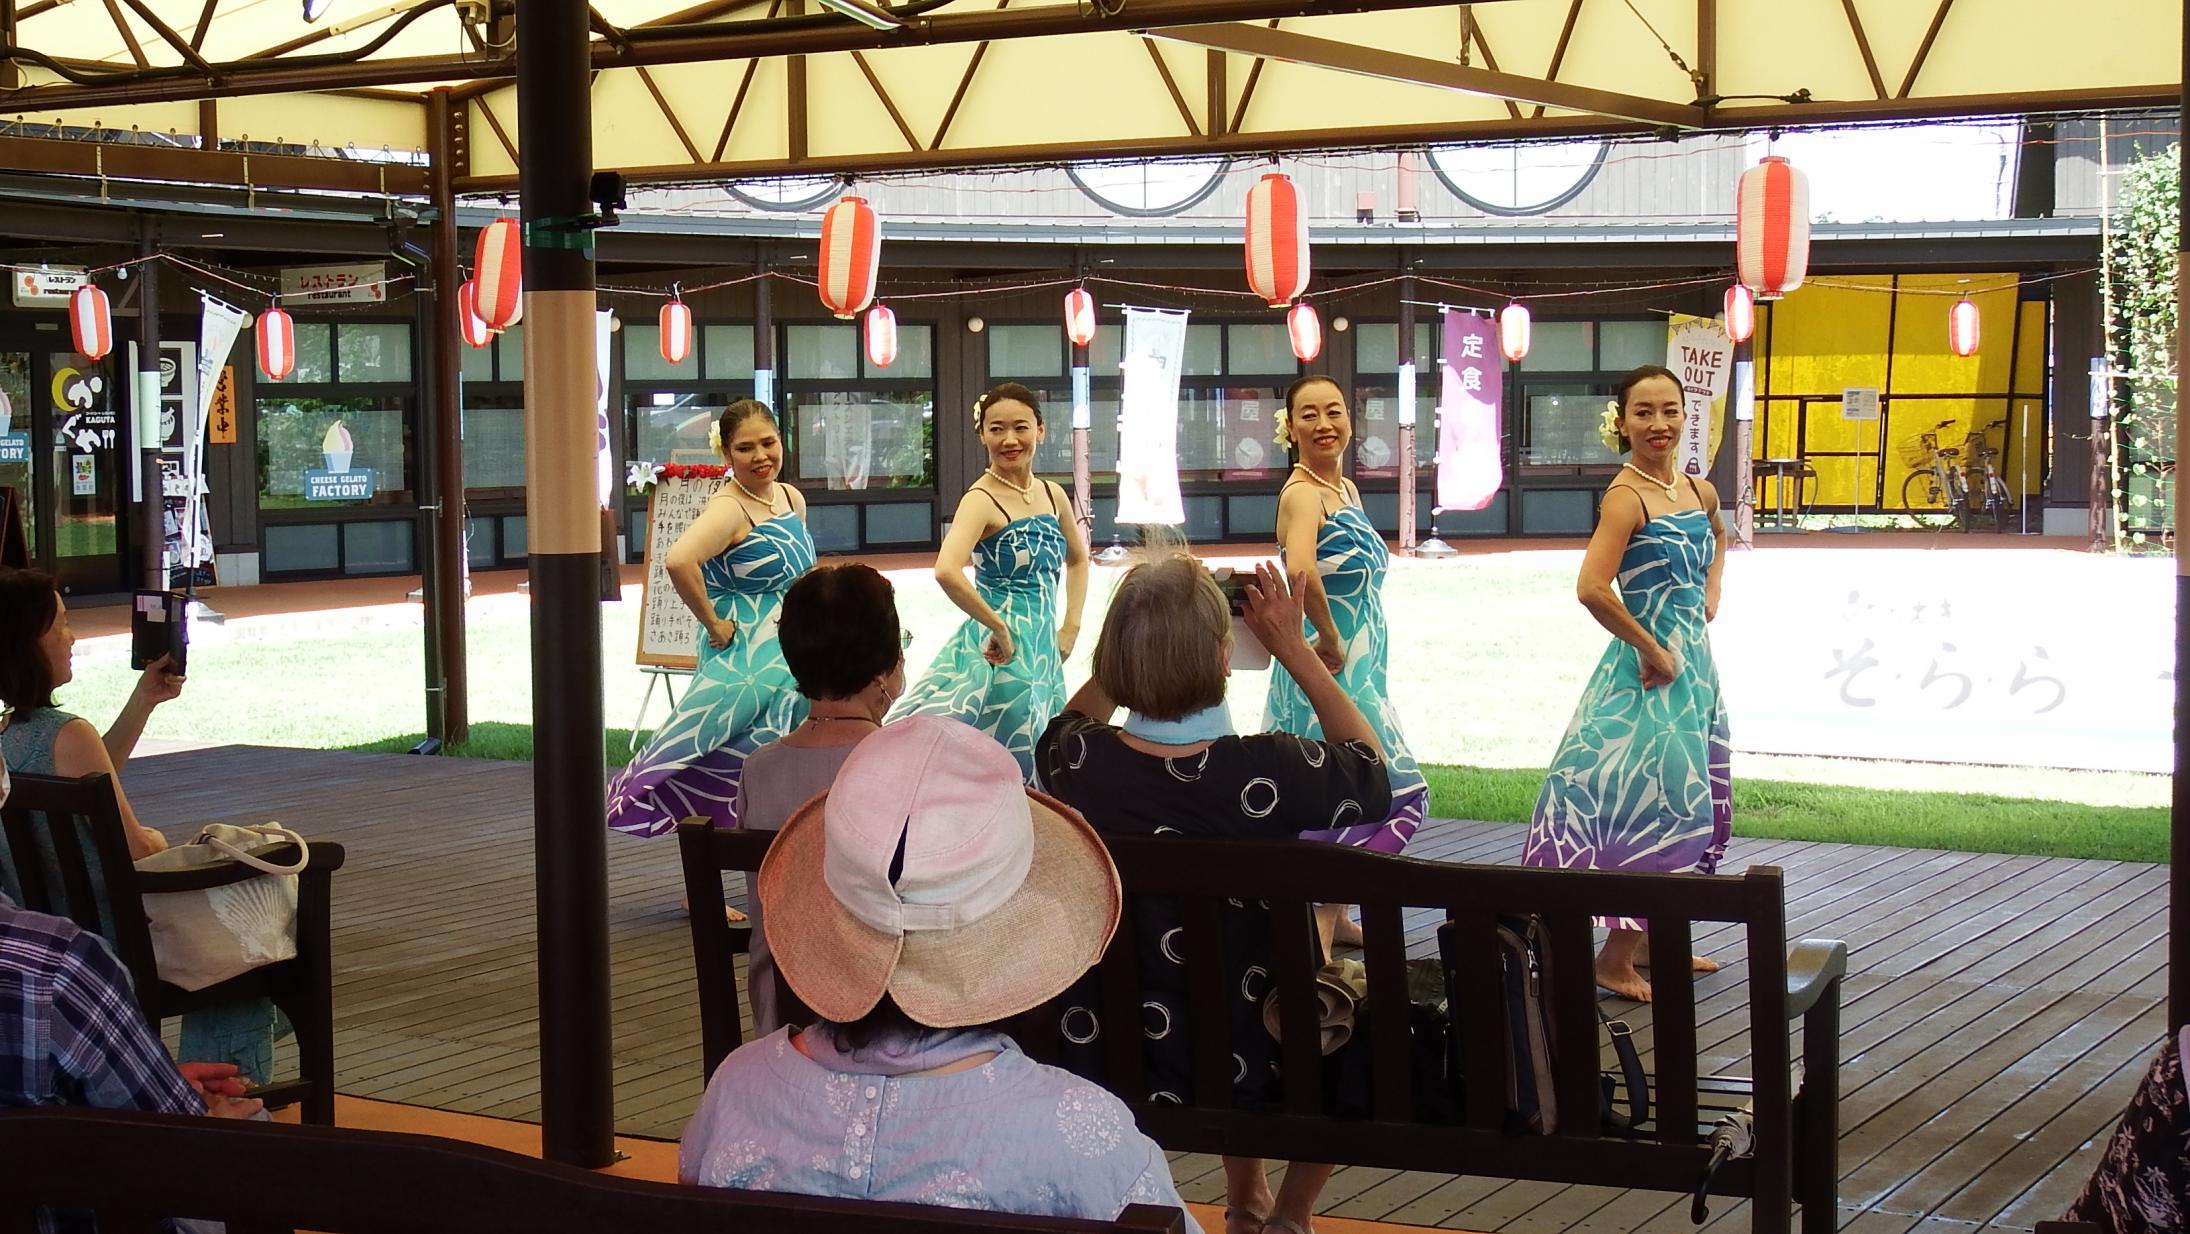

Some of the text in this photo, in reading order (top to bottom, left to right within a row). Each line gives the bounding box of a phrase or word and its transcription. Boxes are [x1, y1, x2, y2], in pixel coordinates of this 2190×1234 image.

[48, 276, 76, 284] レストラン
[300, 273, 359, 289] レストラン
[307, 289, 351, 299] restaurant
[1460, 332, 1484, 392] 定食
[1681, 345, 1723, 369] TAKE
[1684, 366, 1716, 388] OUT
[1689, 399, 1702, 454] できます
[0, 439, 24, 447] GELATO
[0, 448, 24, 459] ORY
[310, 475, 368, 484] CHEESE GELATO
[312, 484, 367, 497] FACTORY
